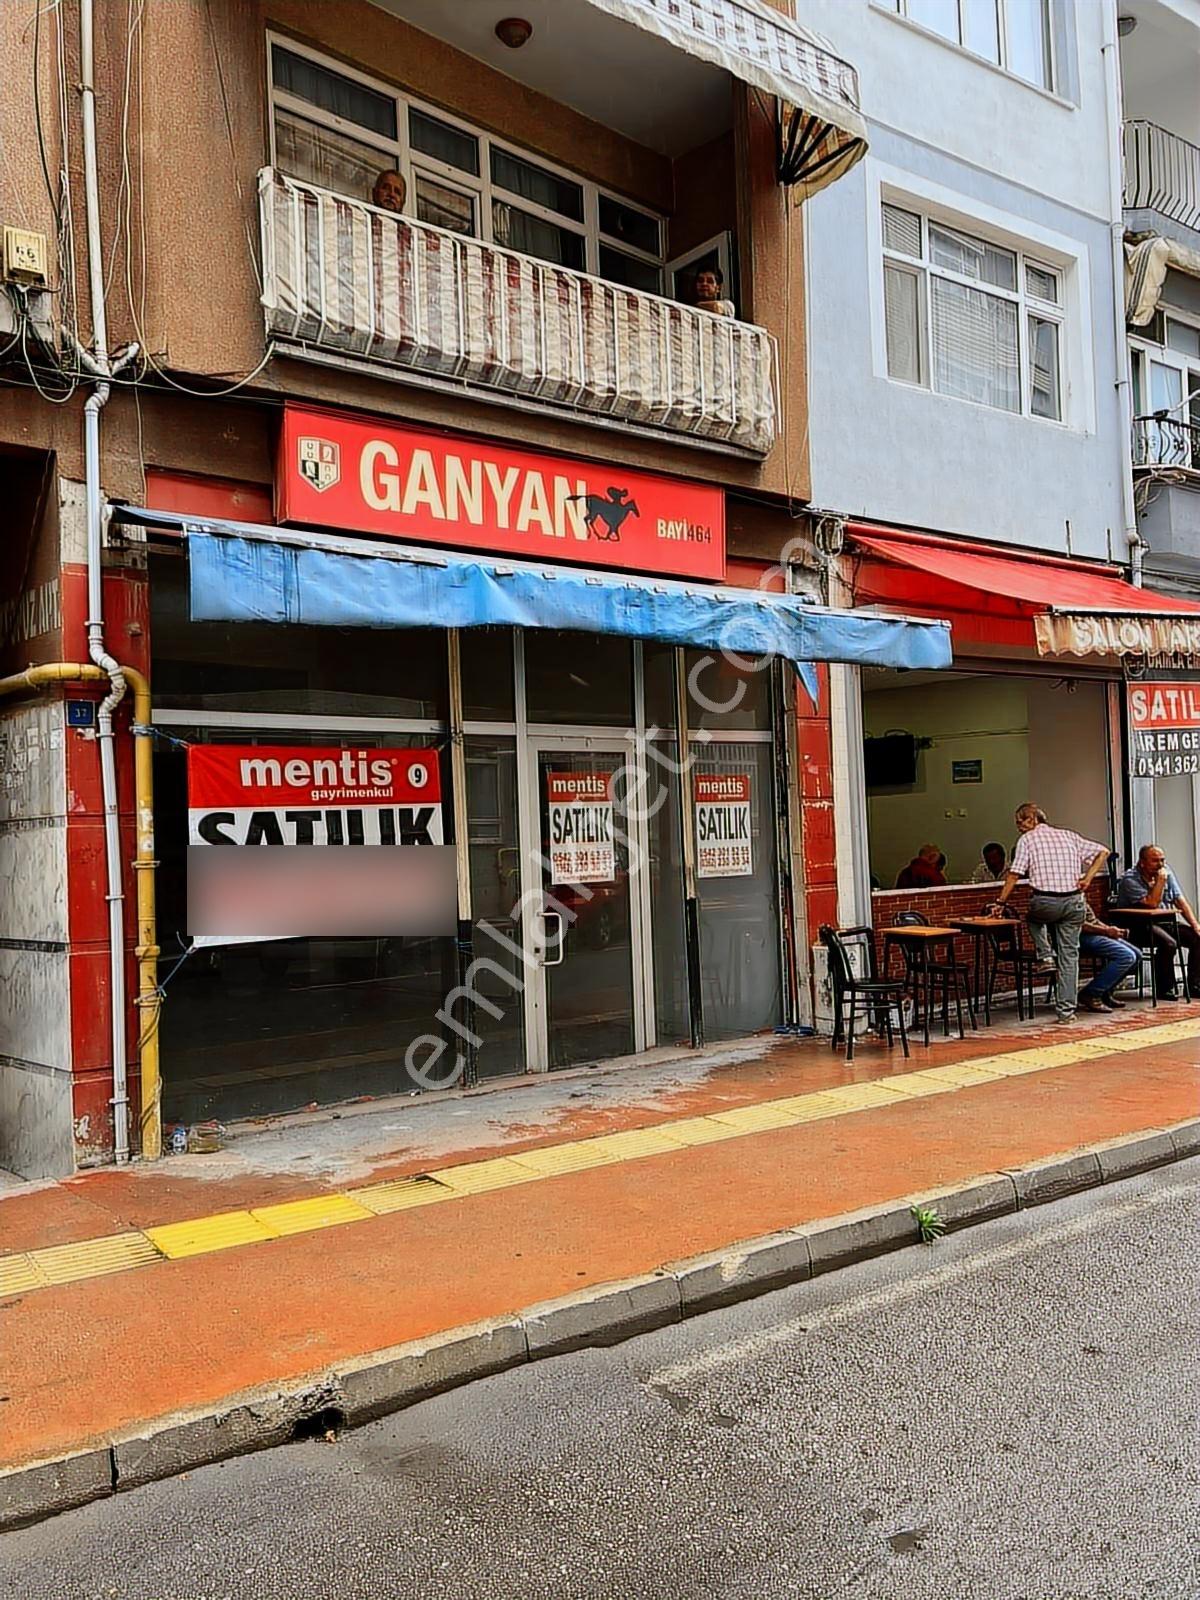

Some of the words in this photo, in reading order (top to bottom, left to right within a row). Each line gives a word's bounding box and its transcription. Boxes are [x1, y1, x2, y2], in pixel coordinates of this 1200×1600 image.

[358, 438, 590, 541] GANYAN
[657, 517, 688, 542] BAYİ
[687, 524, 712, 544] 464
[1073, 620, 1153, 651] SALON
[1131, 689, 1200, 721] SATIL
[240, 750, 393, 787] mentis
[412, 770, 423, 785] 9
[1138, 756, 1171, 776] 0541
[1174, 754, 1198, 775] 362
[310, 786, 393, 801] gayrimenkul
[552, 775, 606, 793] mentis
[698, 777, 744, 794] mentis
[552, 806, 610, 845] SATILIK
[698, 806, 748, 841] SATILIK
